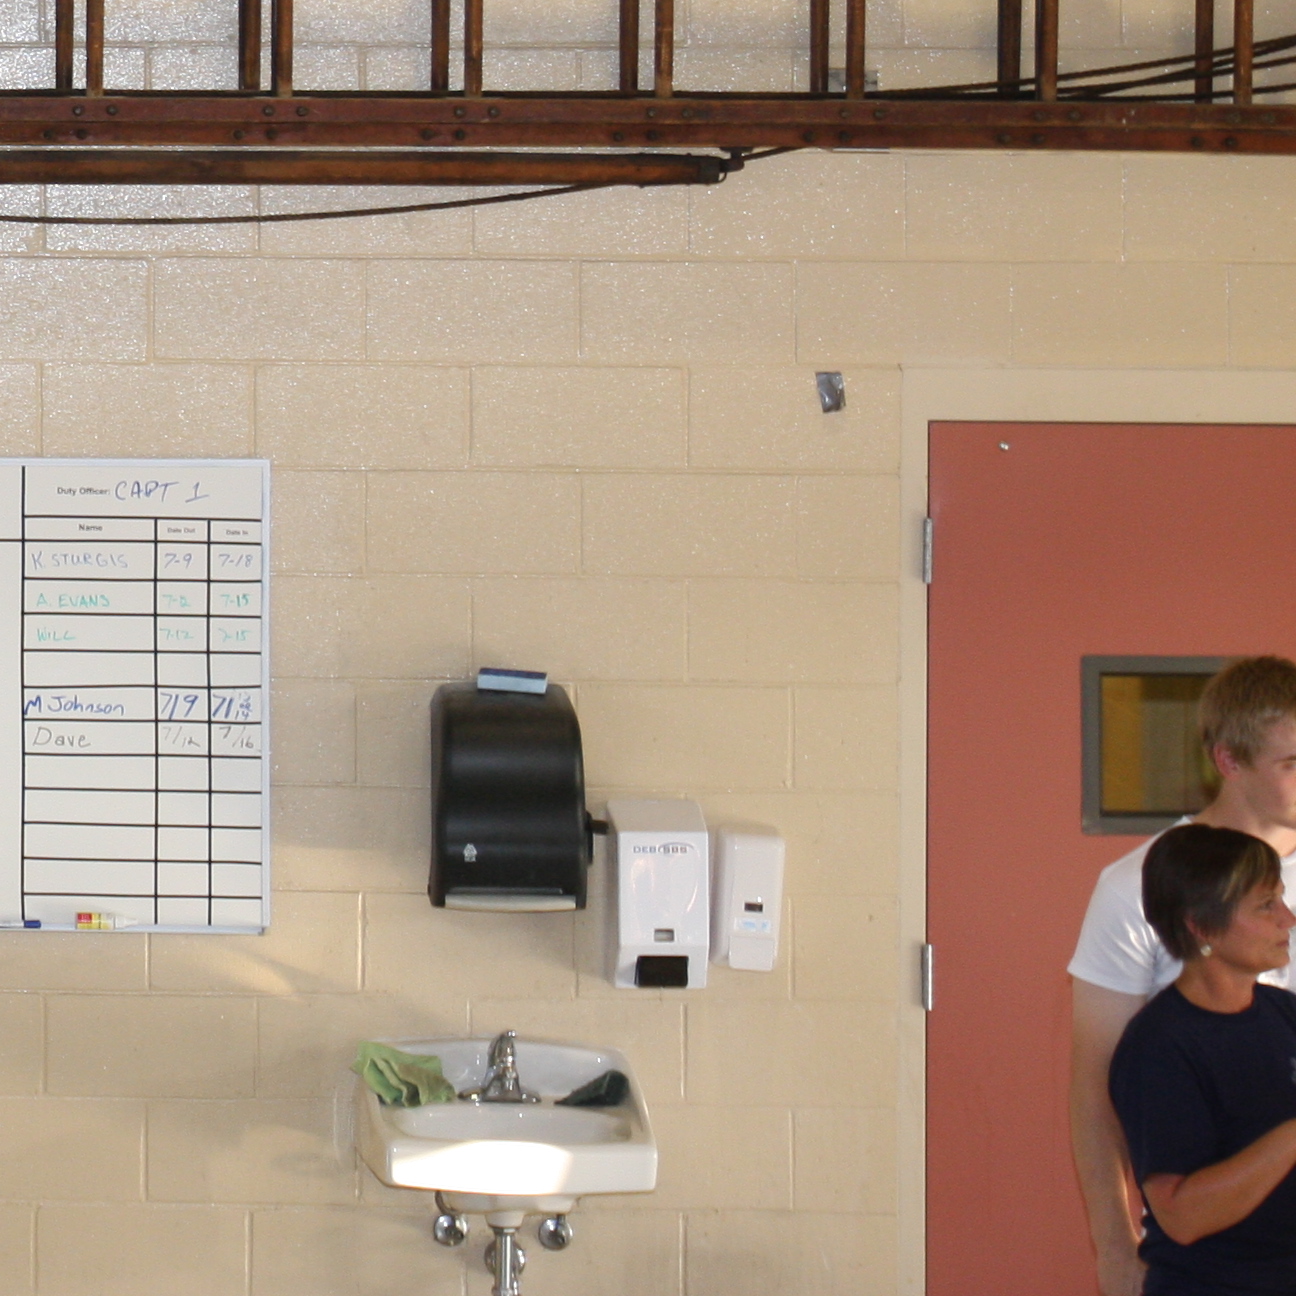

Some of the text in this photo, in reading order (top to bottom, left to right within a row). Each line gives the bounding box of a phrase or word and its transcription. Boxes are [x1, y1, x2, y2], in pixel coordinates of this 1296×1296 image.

[57, 487, 111, 496] Duty Officer:
[115, 480, 180, 503] CAPT
[78, 524, 103, 532] Name
[51, 552, 128, 568] STURGIS
[164, 552, 193, 569] 7-9
[58, 594, 111, 608] EVANS
[24, 694, 124, 716] M Johnson
[32, 726, 91, 748] Dave
